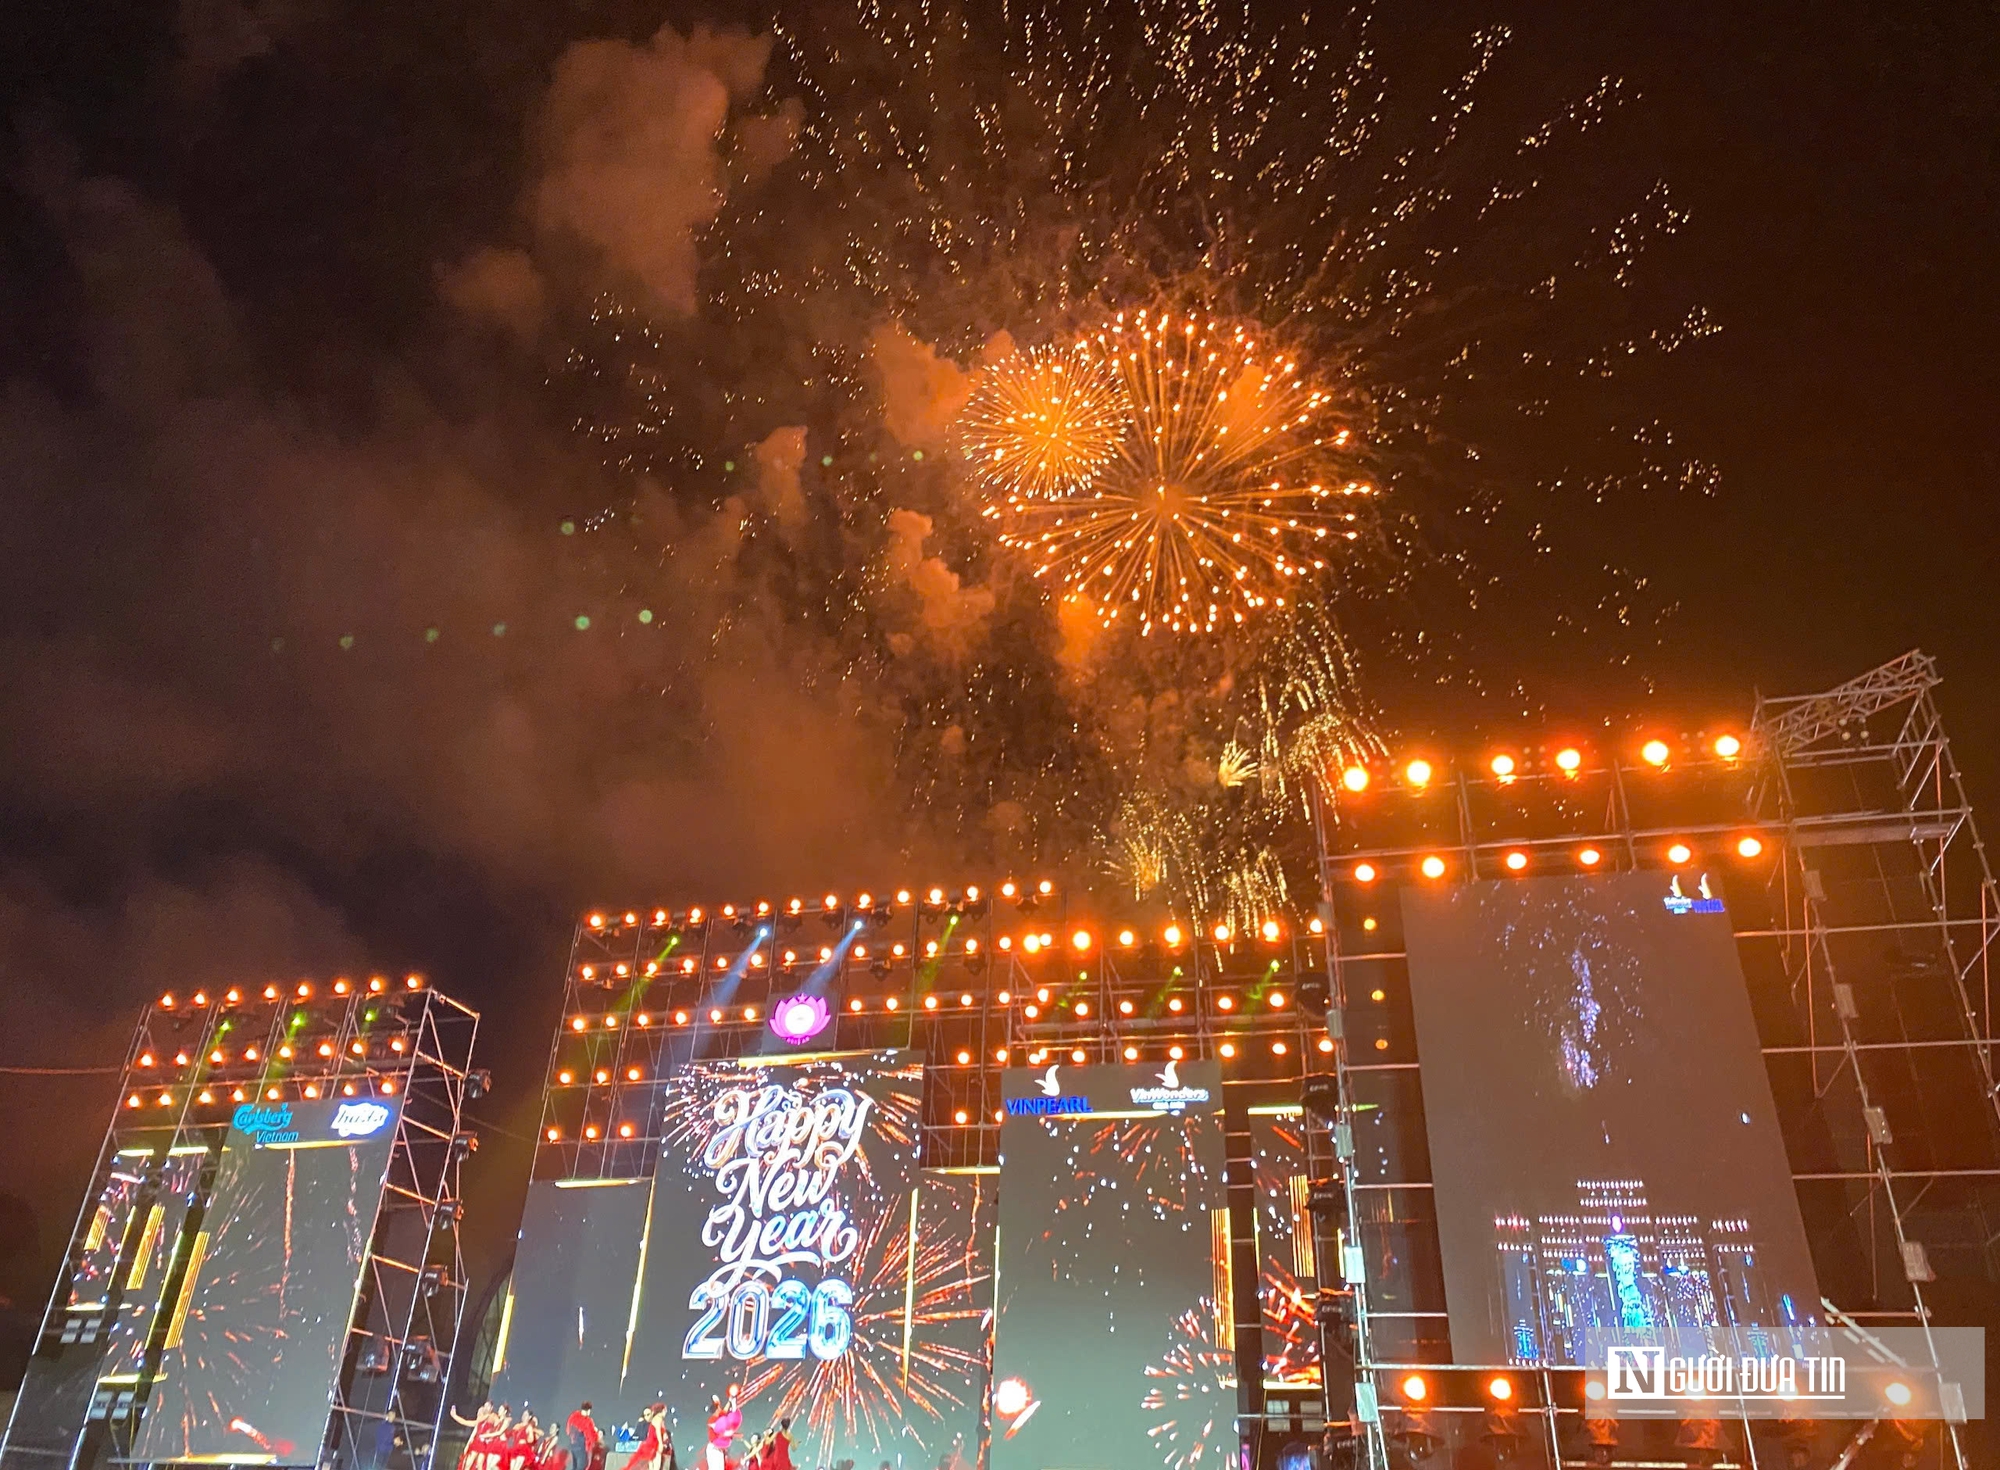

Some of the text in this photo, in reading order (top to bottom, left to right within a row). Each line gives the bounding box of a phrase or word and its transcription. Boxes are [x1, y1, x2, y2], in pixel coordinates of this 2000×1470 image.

[233, 1102, 293, 1134] Carlsberg
[256, 1130, 299, 1143] Vietnam
[704, 1084, 873, 1169] Happy
[1005, 1095, 1093, 1115] VINPEARL
[715, 1148, 845, 1218] New
[701, 1197, 858, 1296] Year
[682, 1278, 853, 1360] 2026
